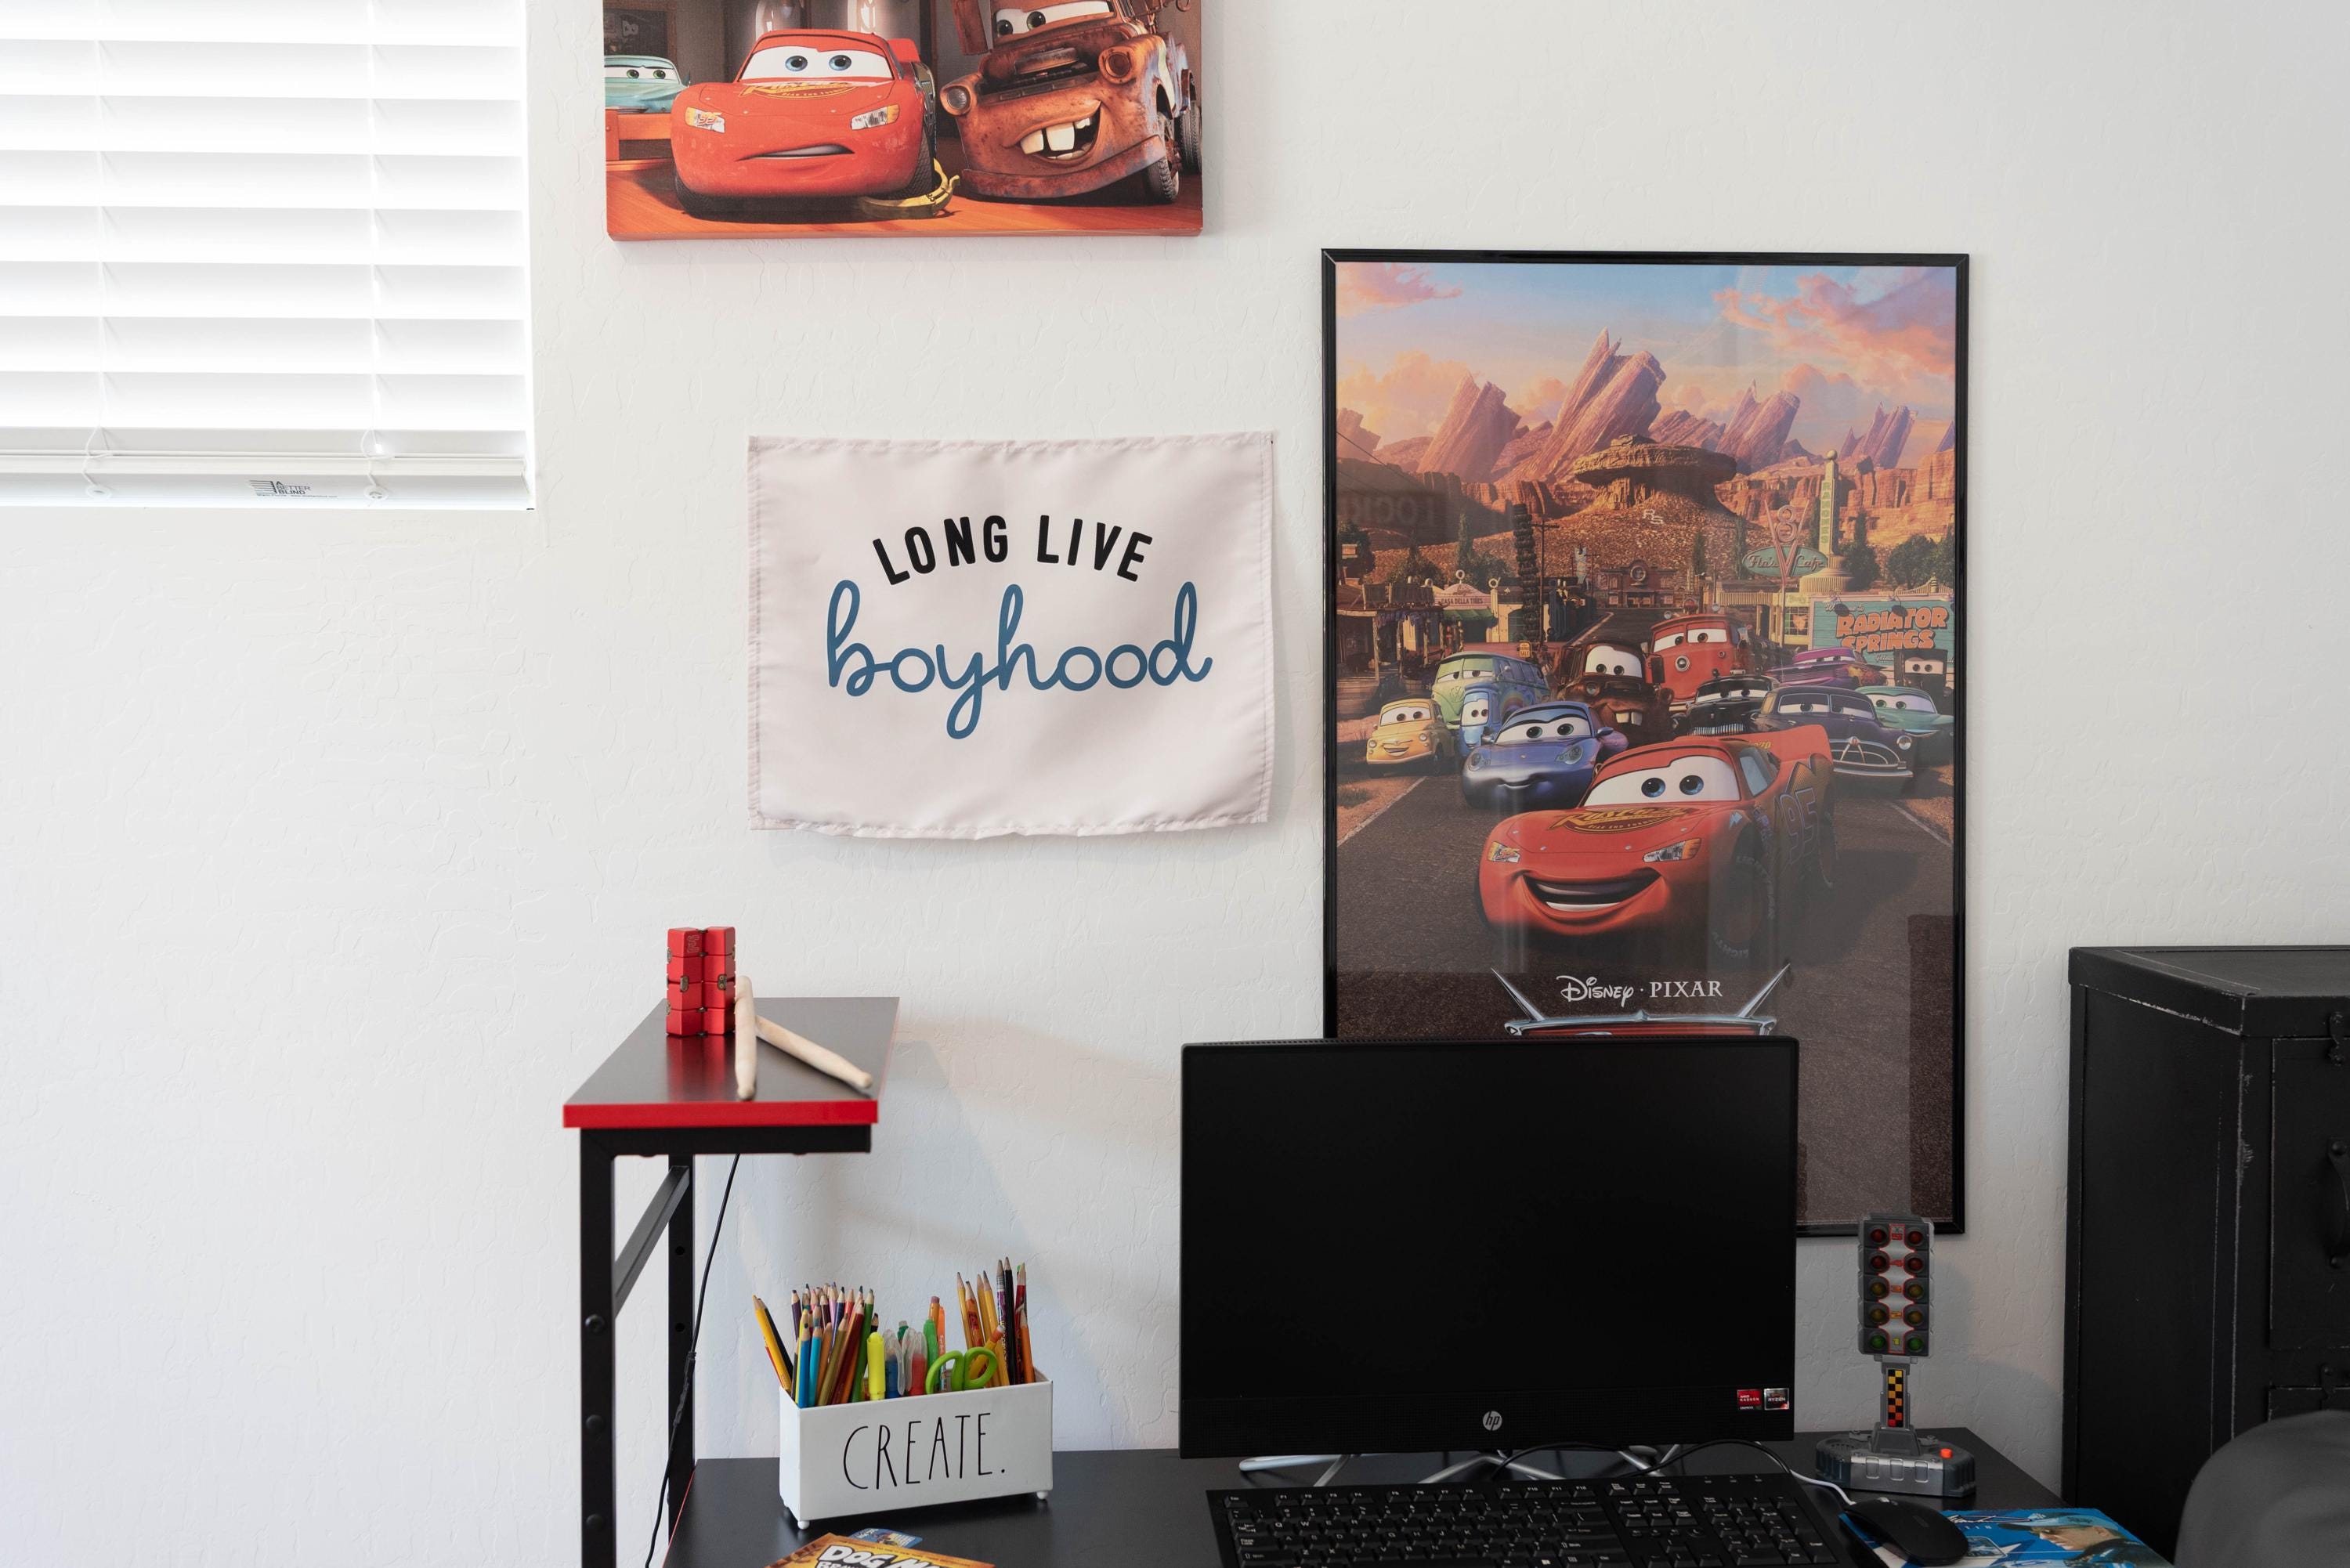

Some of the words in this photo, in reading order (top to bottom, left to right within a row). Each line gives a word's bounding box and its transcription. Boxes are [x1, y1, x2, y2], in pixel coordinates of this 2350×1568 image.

[872, 515, 1008, 585] LONG
[1036, 515, 1153, 582] LIVE
[1836, 606, 1948, 638] RADIATOR
[1841, 629, 1935, 653] SPRINGS
[826, 580, 1213, 739] boyhood
[1649, 981, 1723, 998] PIXAR
[1484, 1411, 1502, 1431] hp
[843, 1412, 1006, 1490] CREATE.
[819, 1545, 898, 1567] DOG
